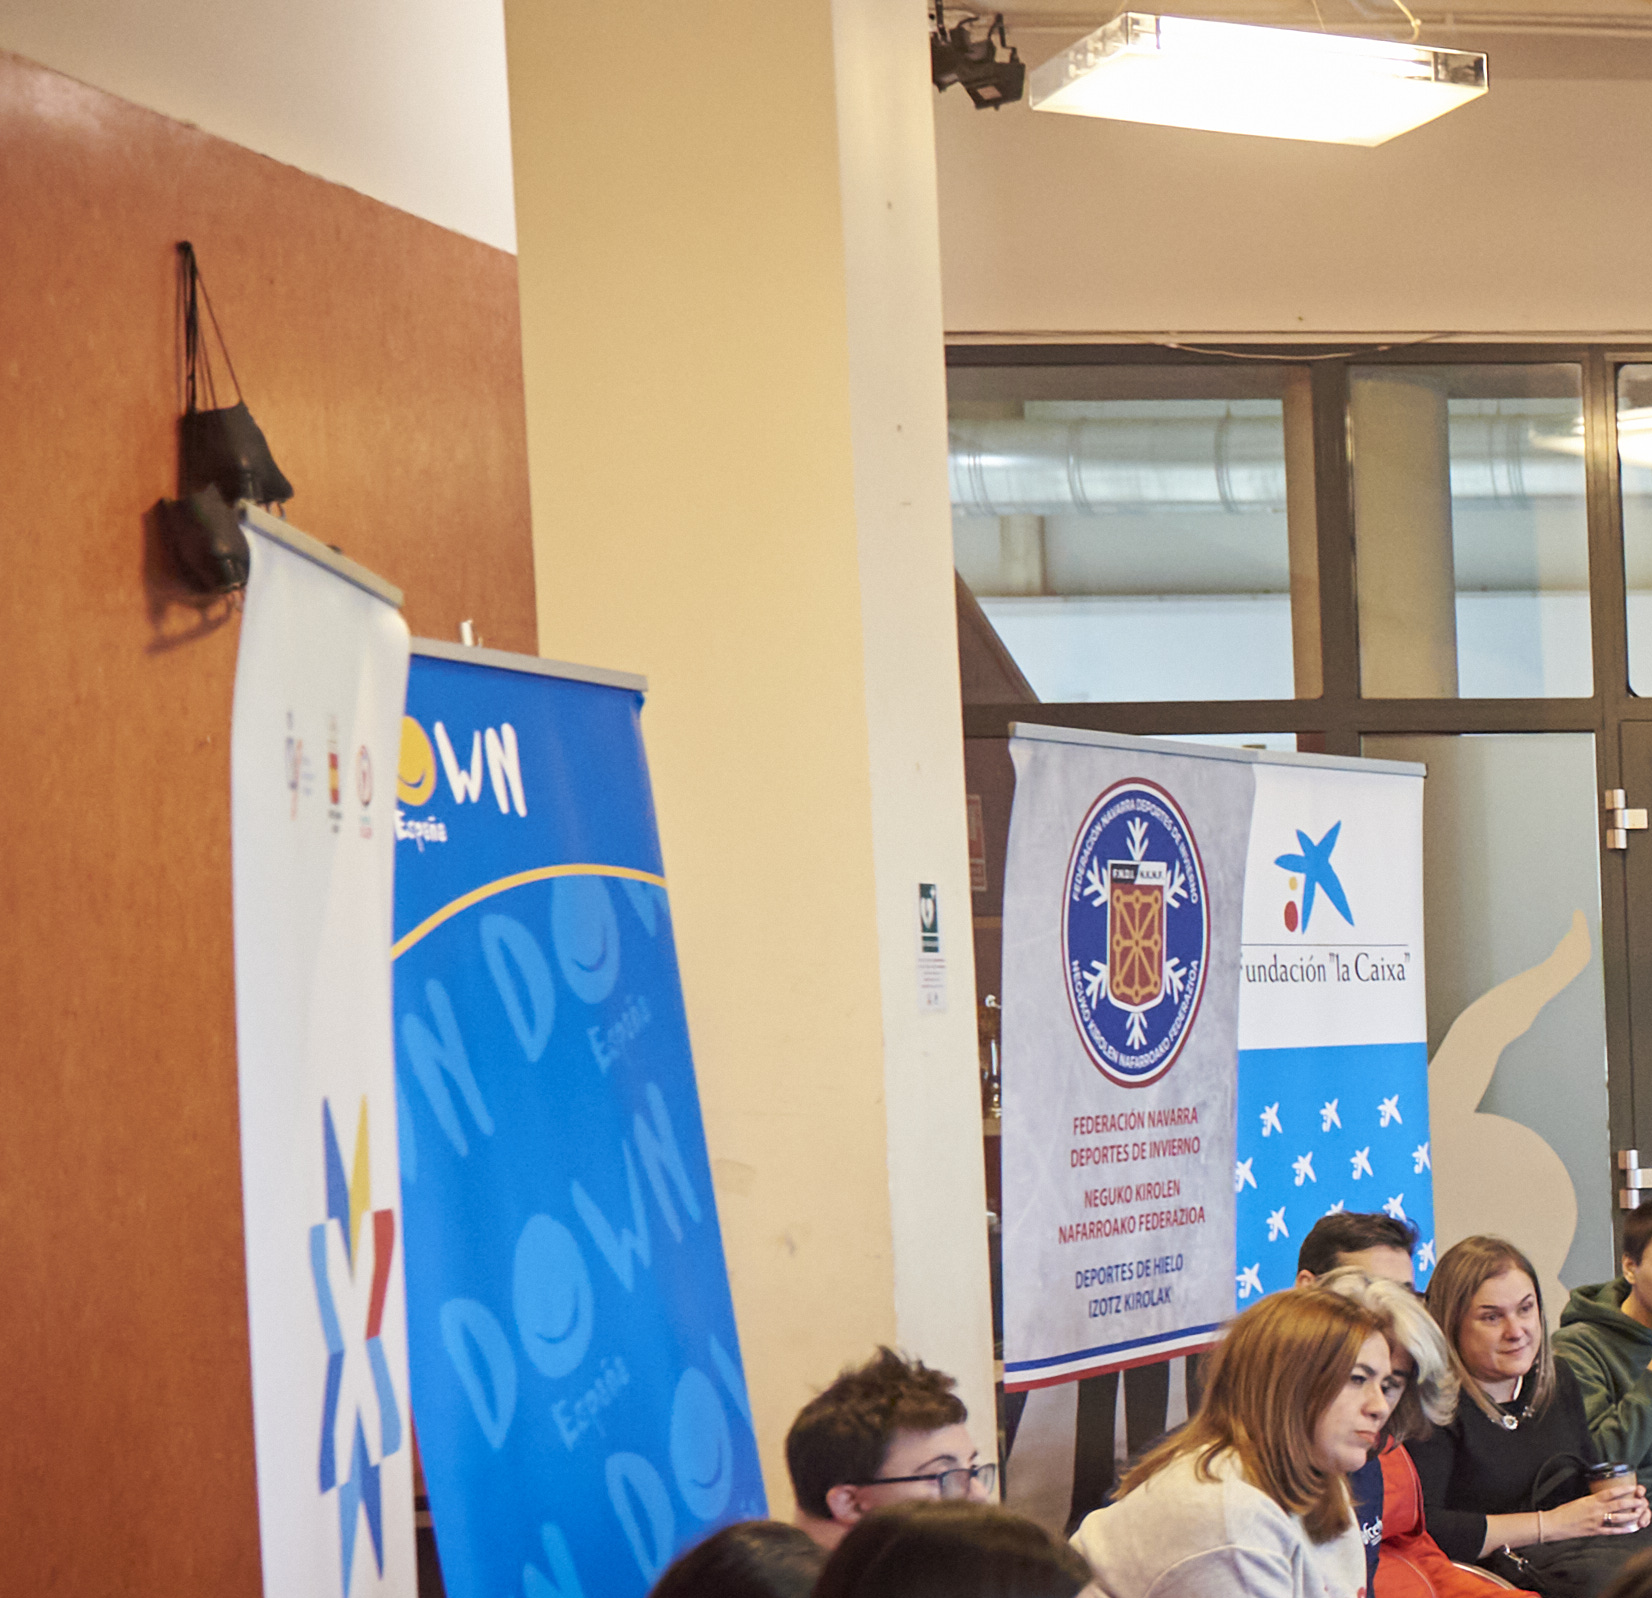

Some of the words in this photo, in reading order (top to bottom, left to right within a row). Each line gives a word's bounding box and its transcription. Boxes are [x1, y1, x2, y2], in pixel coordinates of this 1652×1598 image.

[396, 715, 528, 818] OWN
[1240, 952, 1327, 983] undación
[1073, 1109, 1145, 1136] FEDERACIÓN
[1148, 1106, 1199, 1129] NAVARRA
[1070, 1143, 1129, 1168] DEPORTES
[1132, 1142, 1147, 1161] DE
[1149, 1136, 1201, 1158] INVIERNO
[1084, 1185, 1133, 1208] NEGUKO
[1135, 1179, 1181, 1201] KIROLEN
[1058, 1216, 1136, 1244] NAFARROAKO
[1138, 1206, 1206, 1232] FEDERAZIOA
[1075, 1262, 1134, 1289] DEPORTES
[1137, 1259, 1151, 1279] DE
[1153, 1253, 1184, 1273] HIELO
[1088, 1295, 1123, 1318] IZOTZ
[1124, 1286, 1173, 1311] KIROLAK
